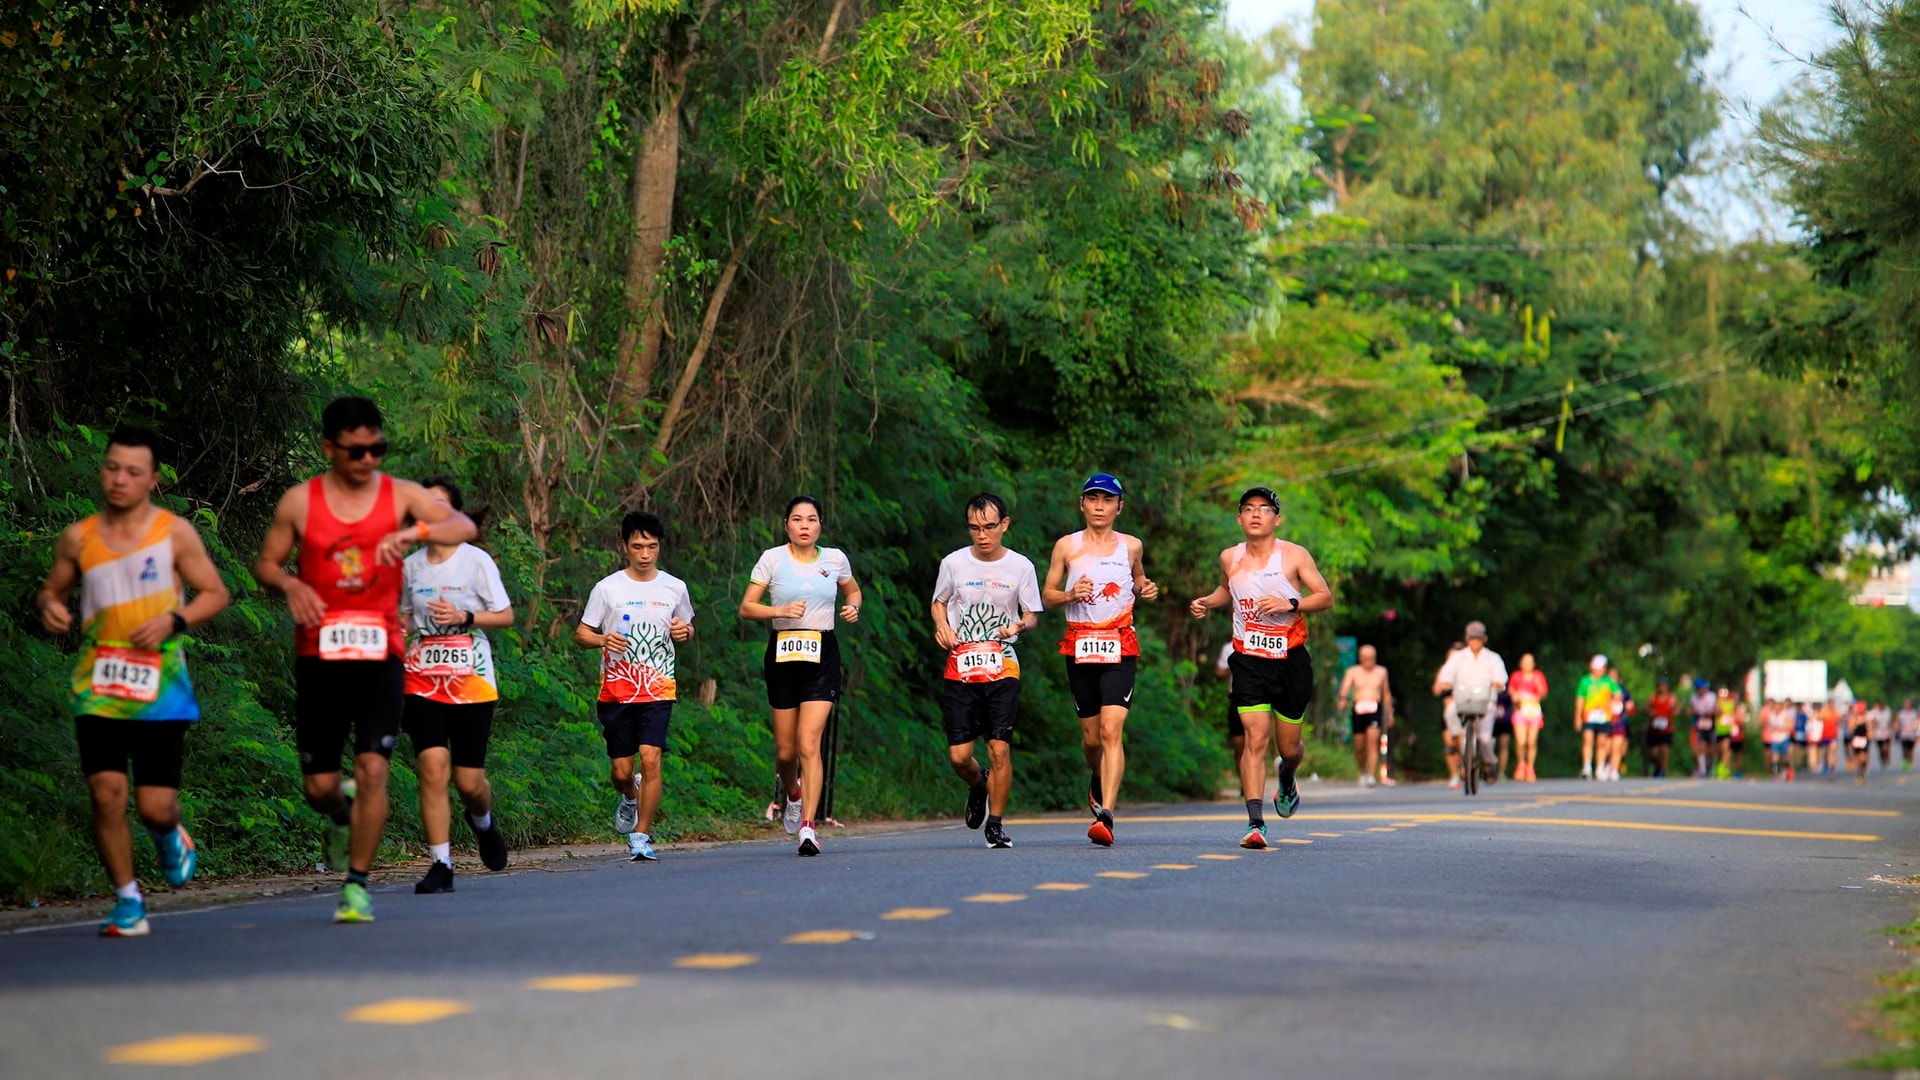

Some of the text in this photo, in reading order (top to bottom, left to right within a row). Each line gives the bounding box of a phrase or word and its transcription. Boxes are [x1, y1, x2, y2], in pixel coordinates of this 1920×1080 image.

[1239, 598, 1254, 610] FM
[329, 628, 379, 645] 41098
[1249, 634, 1283, 649] 41456
[781, 639, 818, 653] 40049
[1082, 641, 1115, 654] 41142
[425, 649, 468, 663] 20265
[963, 652, 996, 667] 41574
[101, 663, 151, 685] 41432
